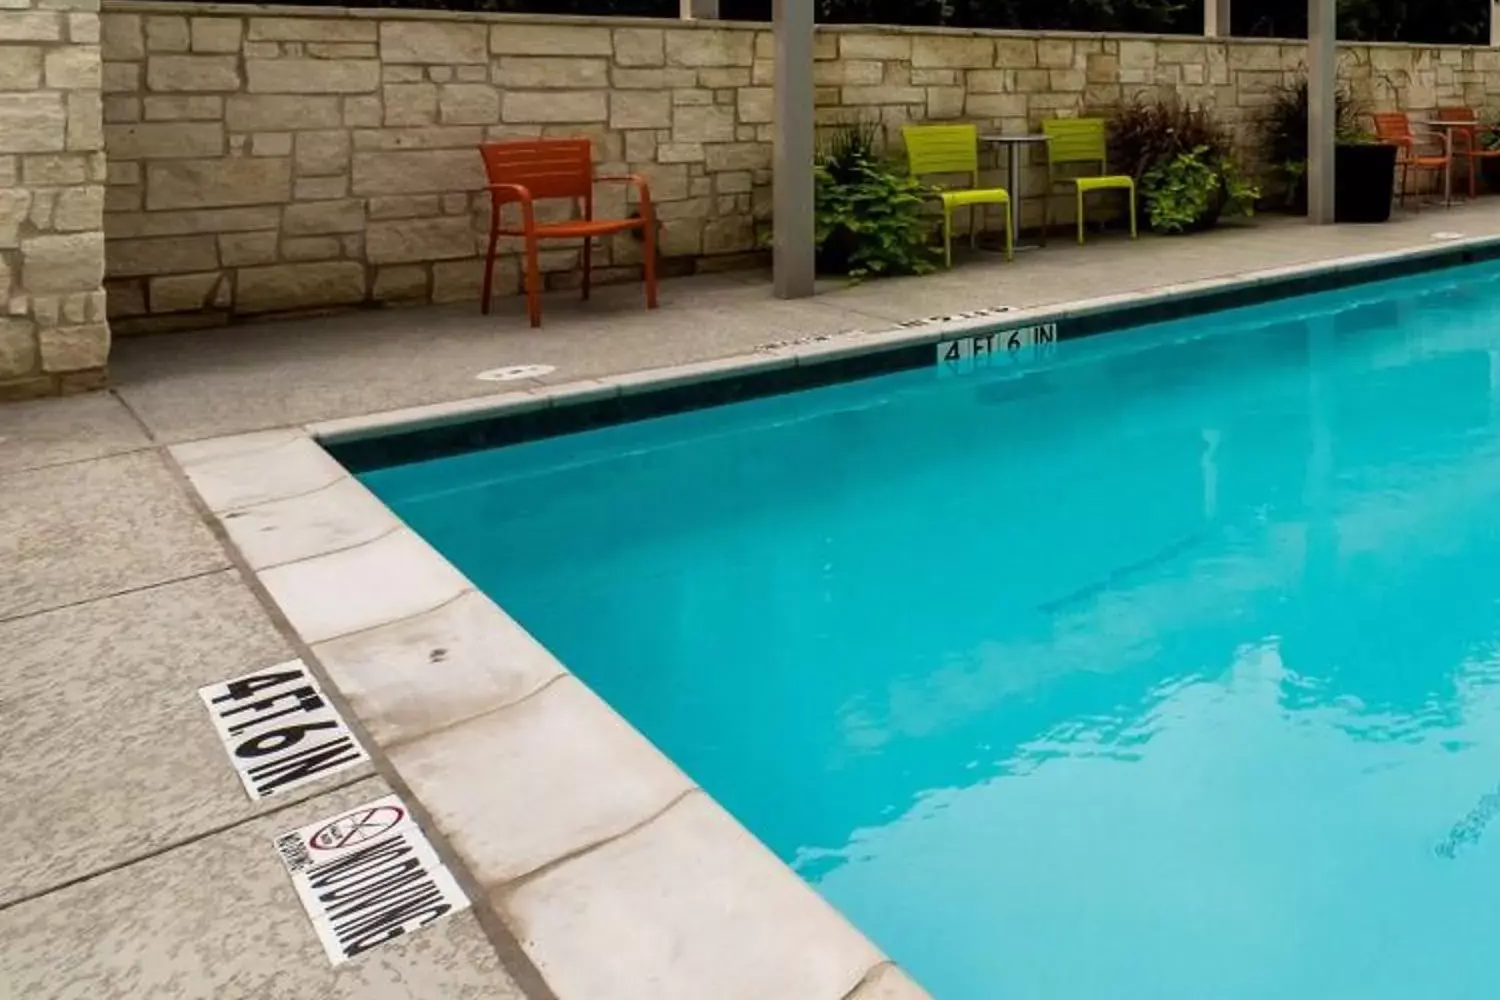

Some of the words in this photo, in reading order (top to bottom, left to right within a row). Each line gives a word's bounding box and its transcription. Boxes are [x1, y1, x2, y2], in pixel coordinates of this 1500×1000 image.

[944, 341, 961, 361] 4
[973, 333, 995, 358] FT
[1007, 331, 1021, 350] 6
[1034, 327, 1054, 345] IN
[211, 669, 305, 705] 4
[234, 720, 339, 759] 6
[305, 833, 414, 889] NO
[318, 857, 453, 958] DIVING
